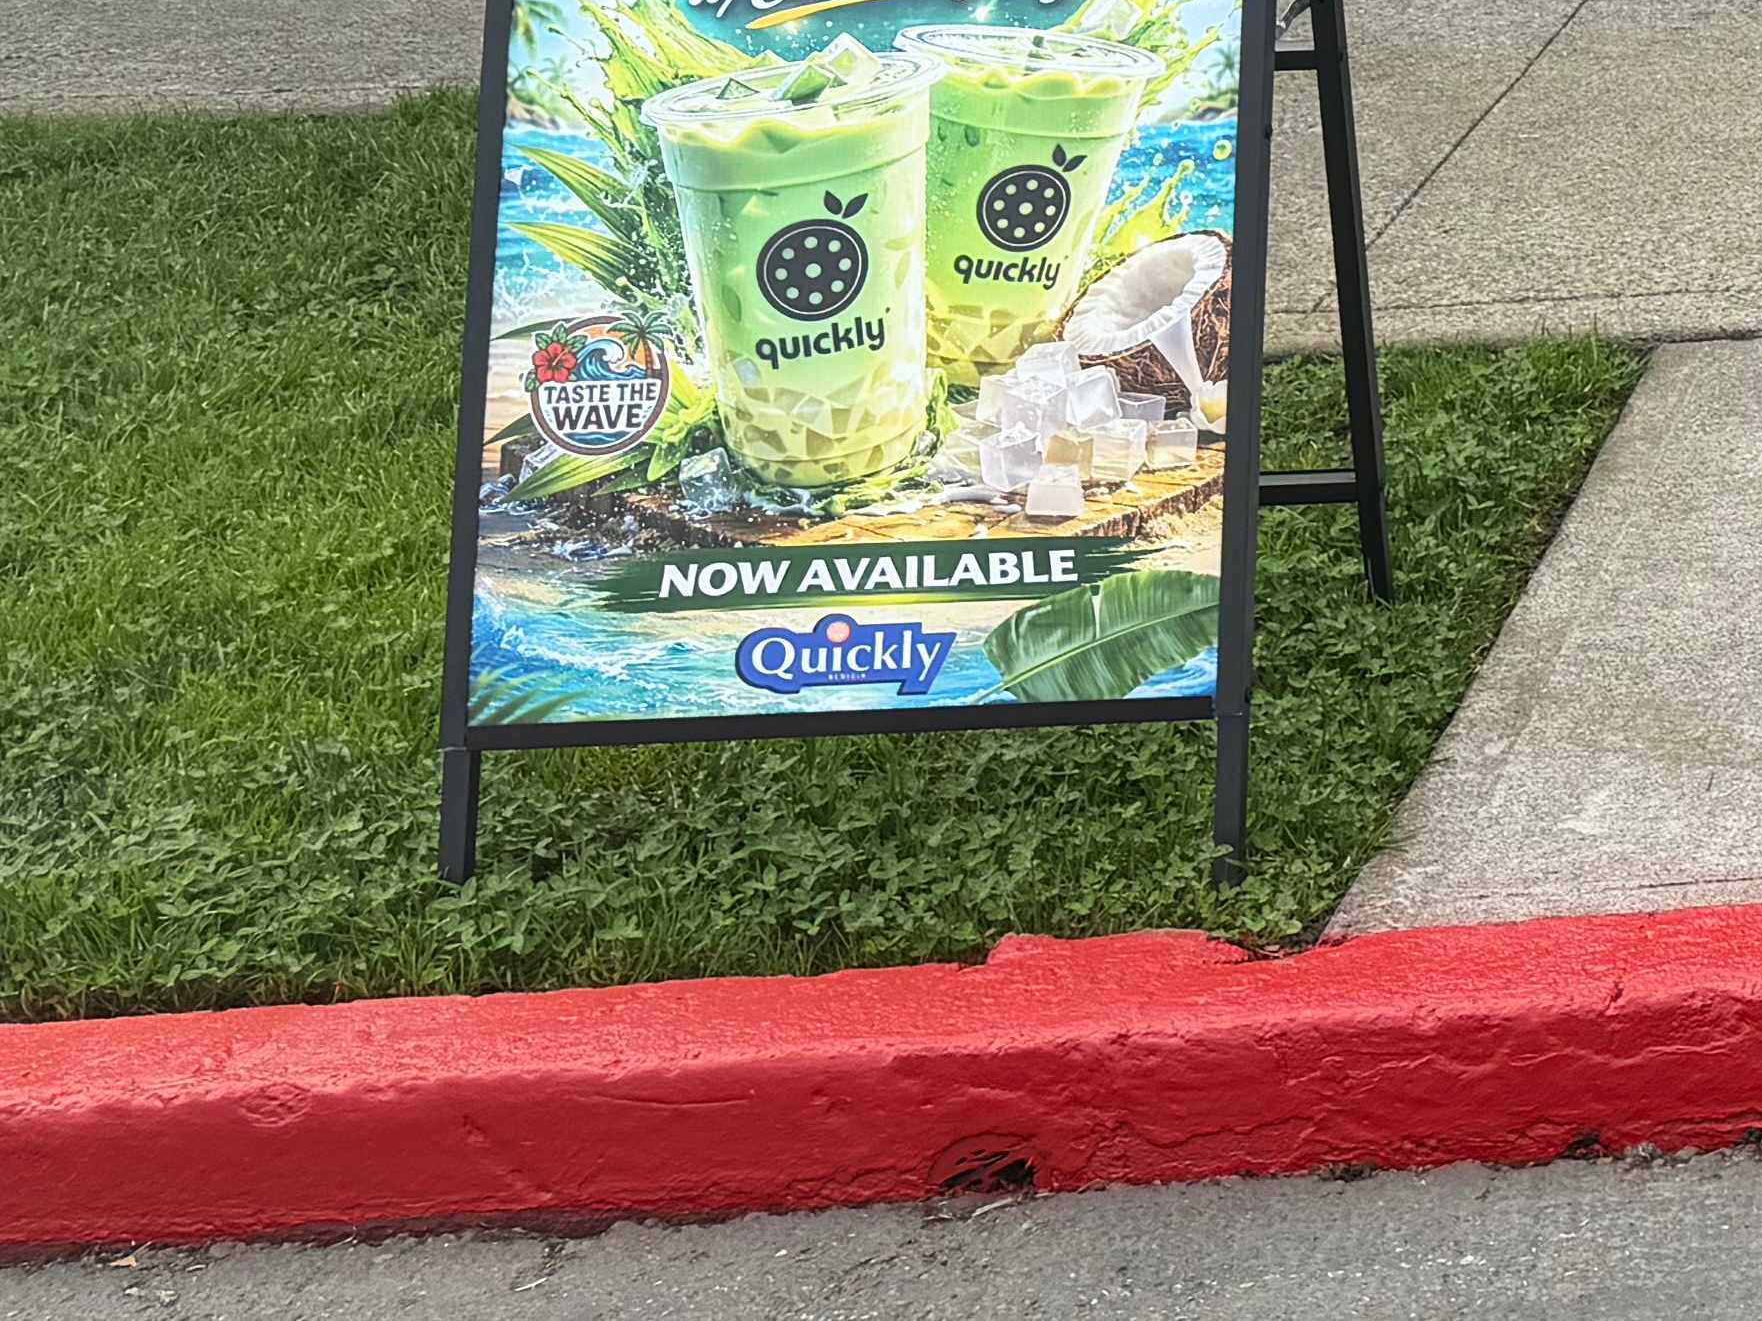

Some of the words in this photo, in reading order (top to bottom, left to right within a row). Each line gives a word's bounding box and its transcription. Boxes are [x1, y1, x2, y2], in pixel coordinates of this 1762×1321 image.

[953, 254, 1062, 289] quickly
[754, 315, 887, 369] quickly
[543, 383, 610, 405] TASTE
[616, 382, 657, 401] THE
[552, 405, 643, 431] WAVE
[658, 560, 792, 598] NOW
[796, 549, 1080, 593] AVAILABLE
[750, 620, 945, 682] Quickly
